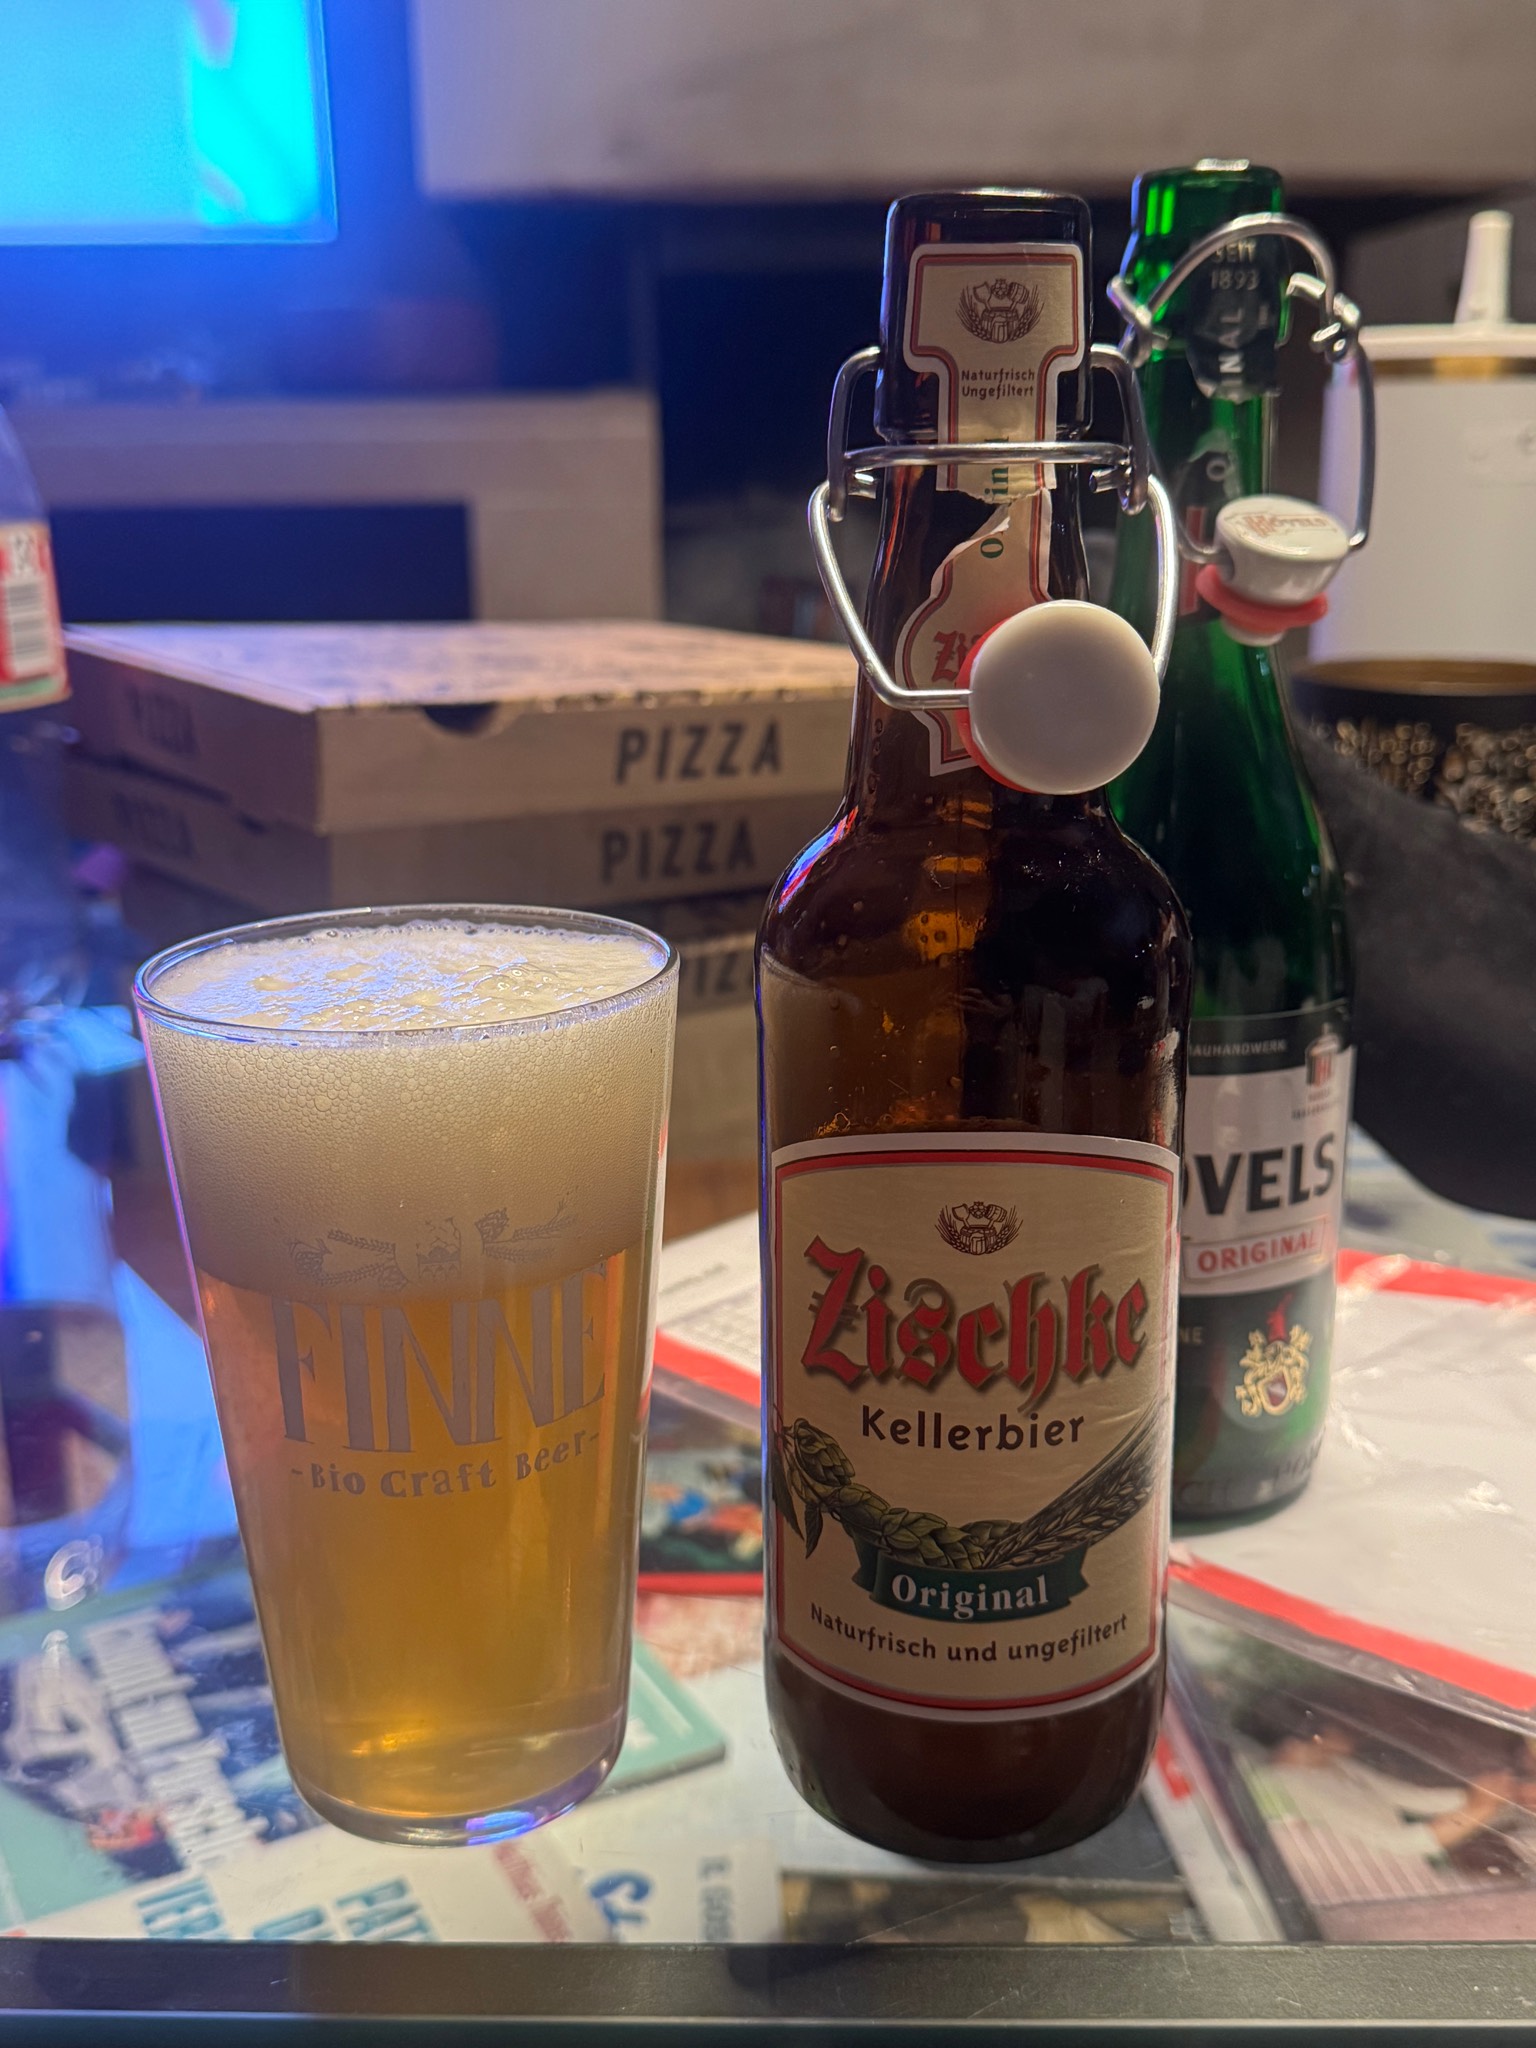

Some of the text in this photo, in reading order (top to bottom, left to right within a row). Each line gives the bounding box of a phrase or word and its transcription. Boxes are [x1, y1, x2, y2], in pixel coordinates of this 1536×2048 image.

[961, 369, 1036, 385] Naturfrisch
[961, 385, 1035, 400] Ungefiltert
[616, 719, 783, 785] PIZZA
[603, 818, 757, 884] PIZZA
[1184, 1133, 1336, 1215] VELS
[1196, 1229, 1319, 1275] ORIGINAL
[801, 1236, 1149, 1411] Zischke
[272, 1266, 607, 1453] FINNE
[861, 1405, 1085, 1451] Kellerbier
[380, 1458, 497, 1498] Craft
[892, 1574, 1050, 1619] Original
[810, 1603, 1129, 1662] Naturfrisch und ungefiltert
